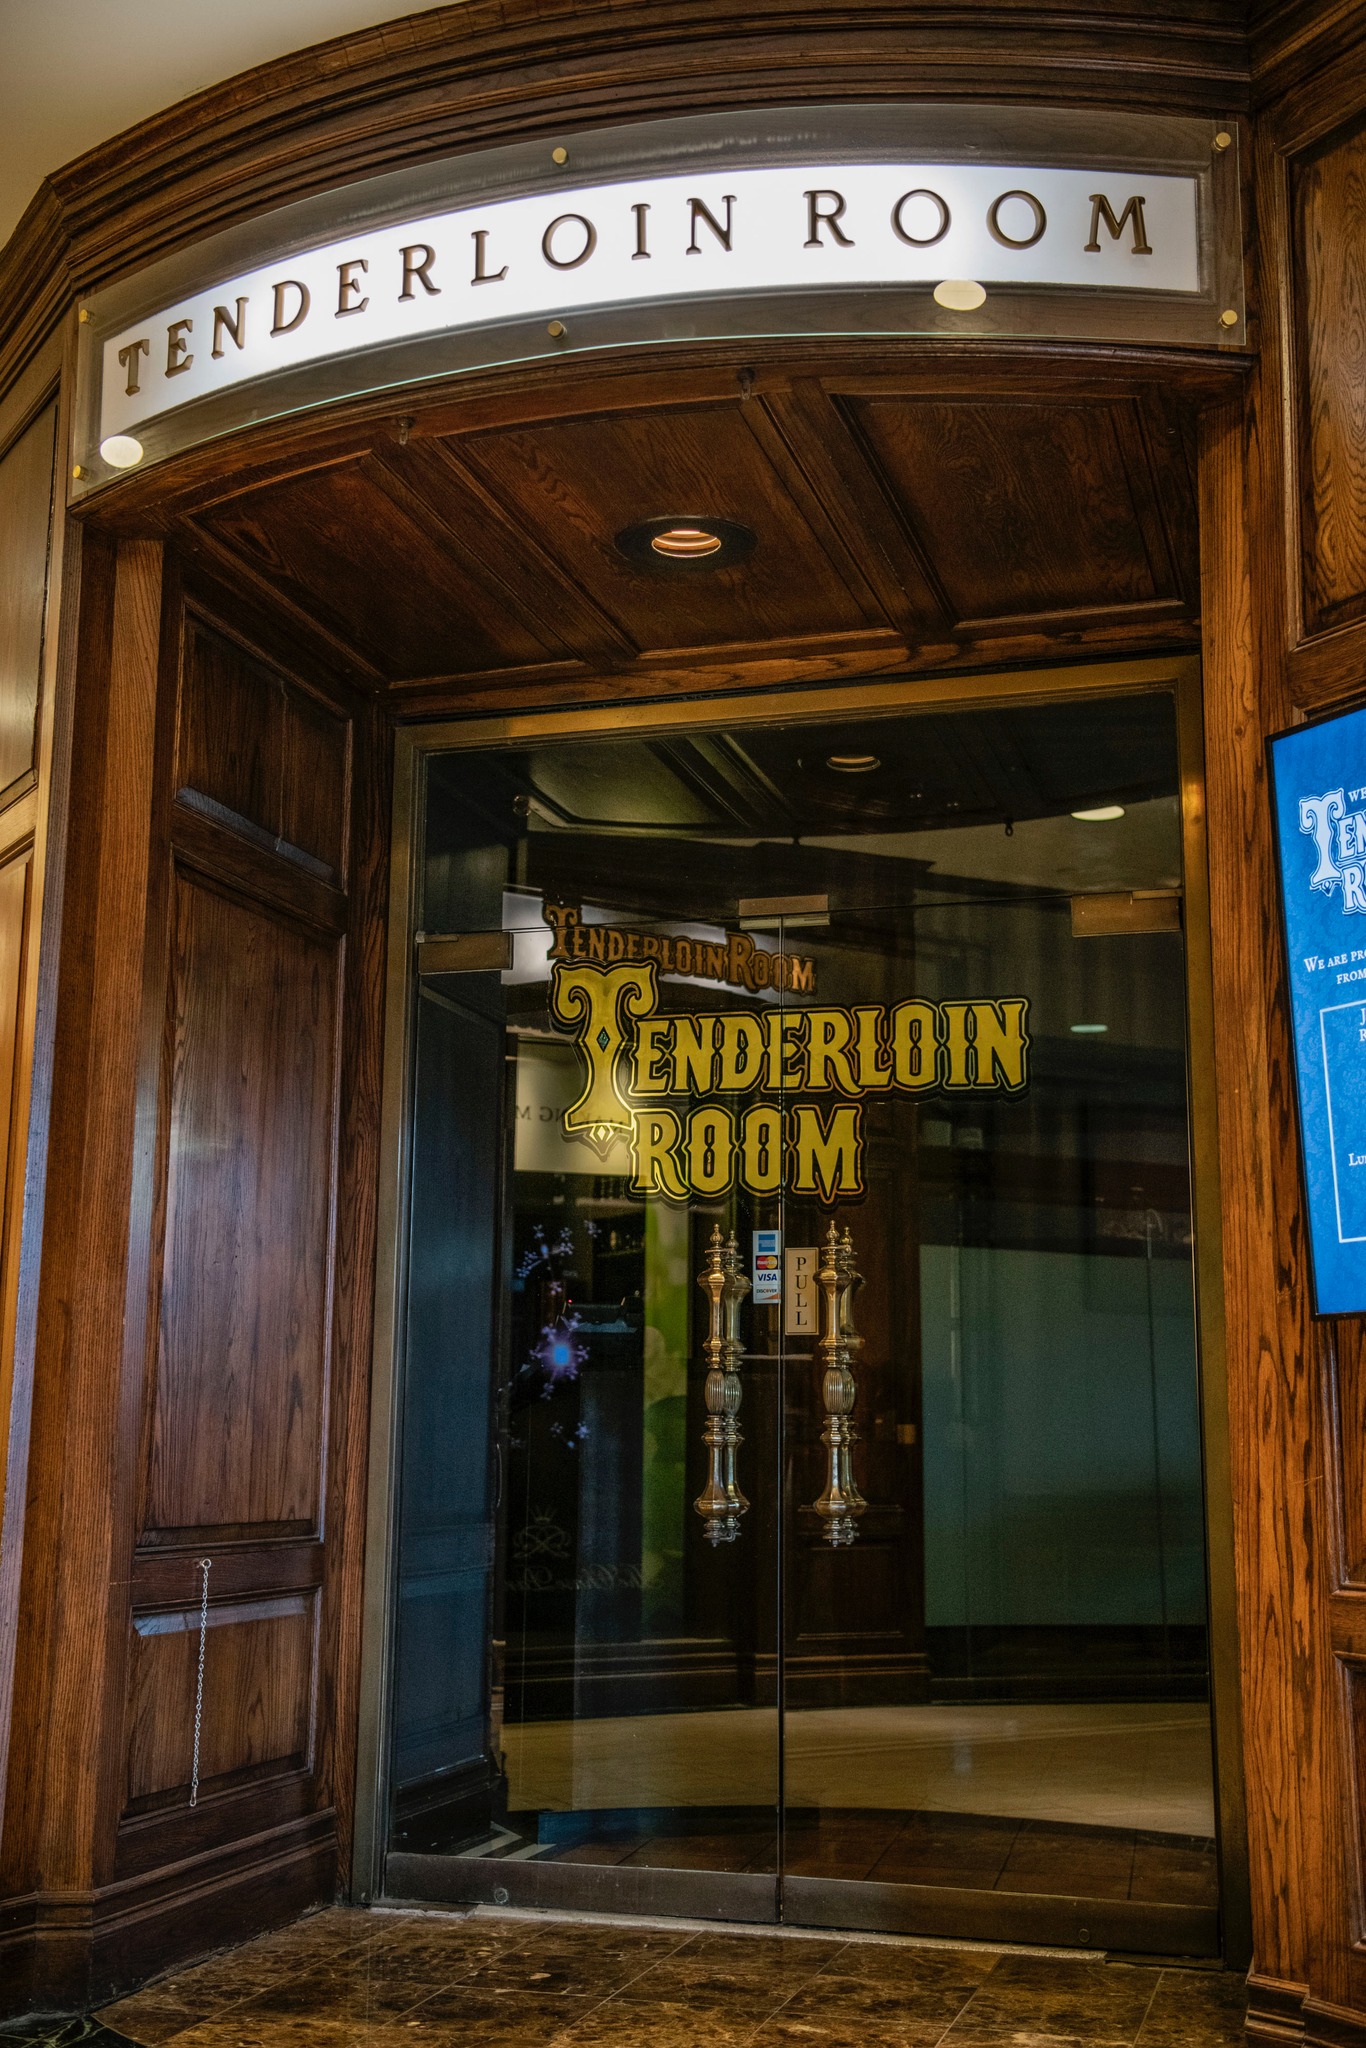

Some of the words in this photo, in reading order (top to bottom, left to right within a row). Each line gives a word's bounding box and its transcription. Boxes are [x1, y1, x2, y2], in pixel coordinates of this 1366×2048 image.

[118, 194, 738, 397] TENDERLOIN
[803, 188, 1153, 255] ROOM
[1304, 956, 1325, 973] WE
[1327, 954, 1348, 968] ARE
[551, 960, 1030, 1140] TENDERLOIN
[628, 1102, 866, 1204] ROOM
[757, 1273, 778, 1281] VISA
[795, 1256, 808, 1326] PULL
